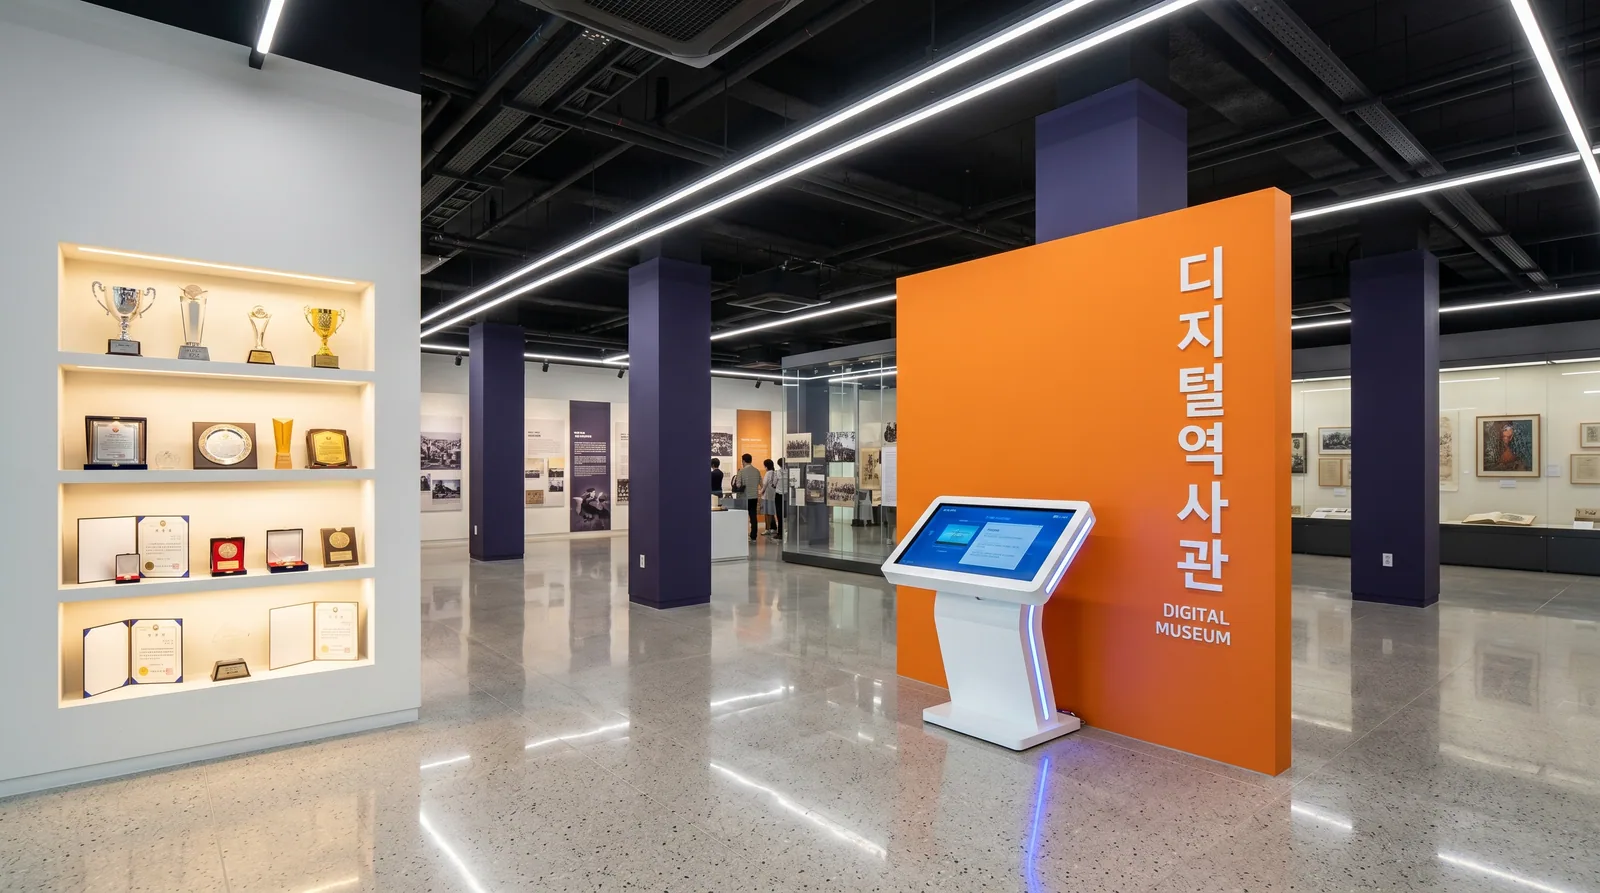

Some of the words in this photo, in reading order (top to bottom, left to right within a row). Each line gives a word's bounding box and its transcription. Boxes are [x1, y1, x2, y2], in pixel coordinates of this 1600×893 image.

[1177, 246, 1228, 592] 디지털역사관
[1163, 602, 1230, 626] DIGITAL
[1155, 620, 1231, 646] MUSEUM
